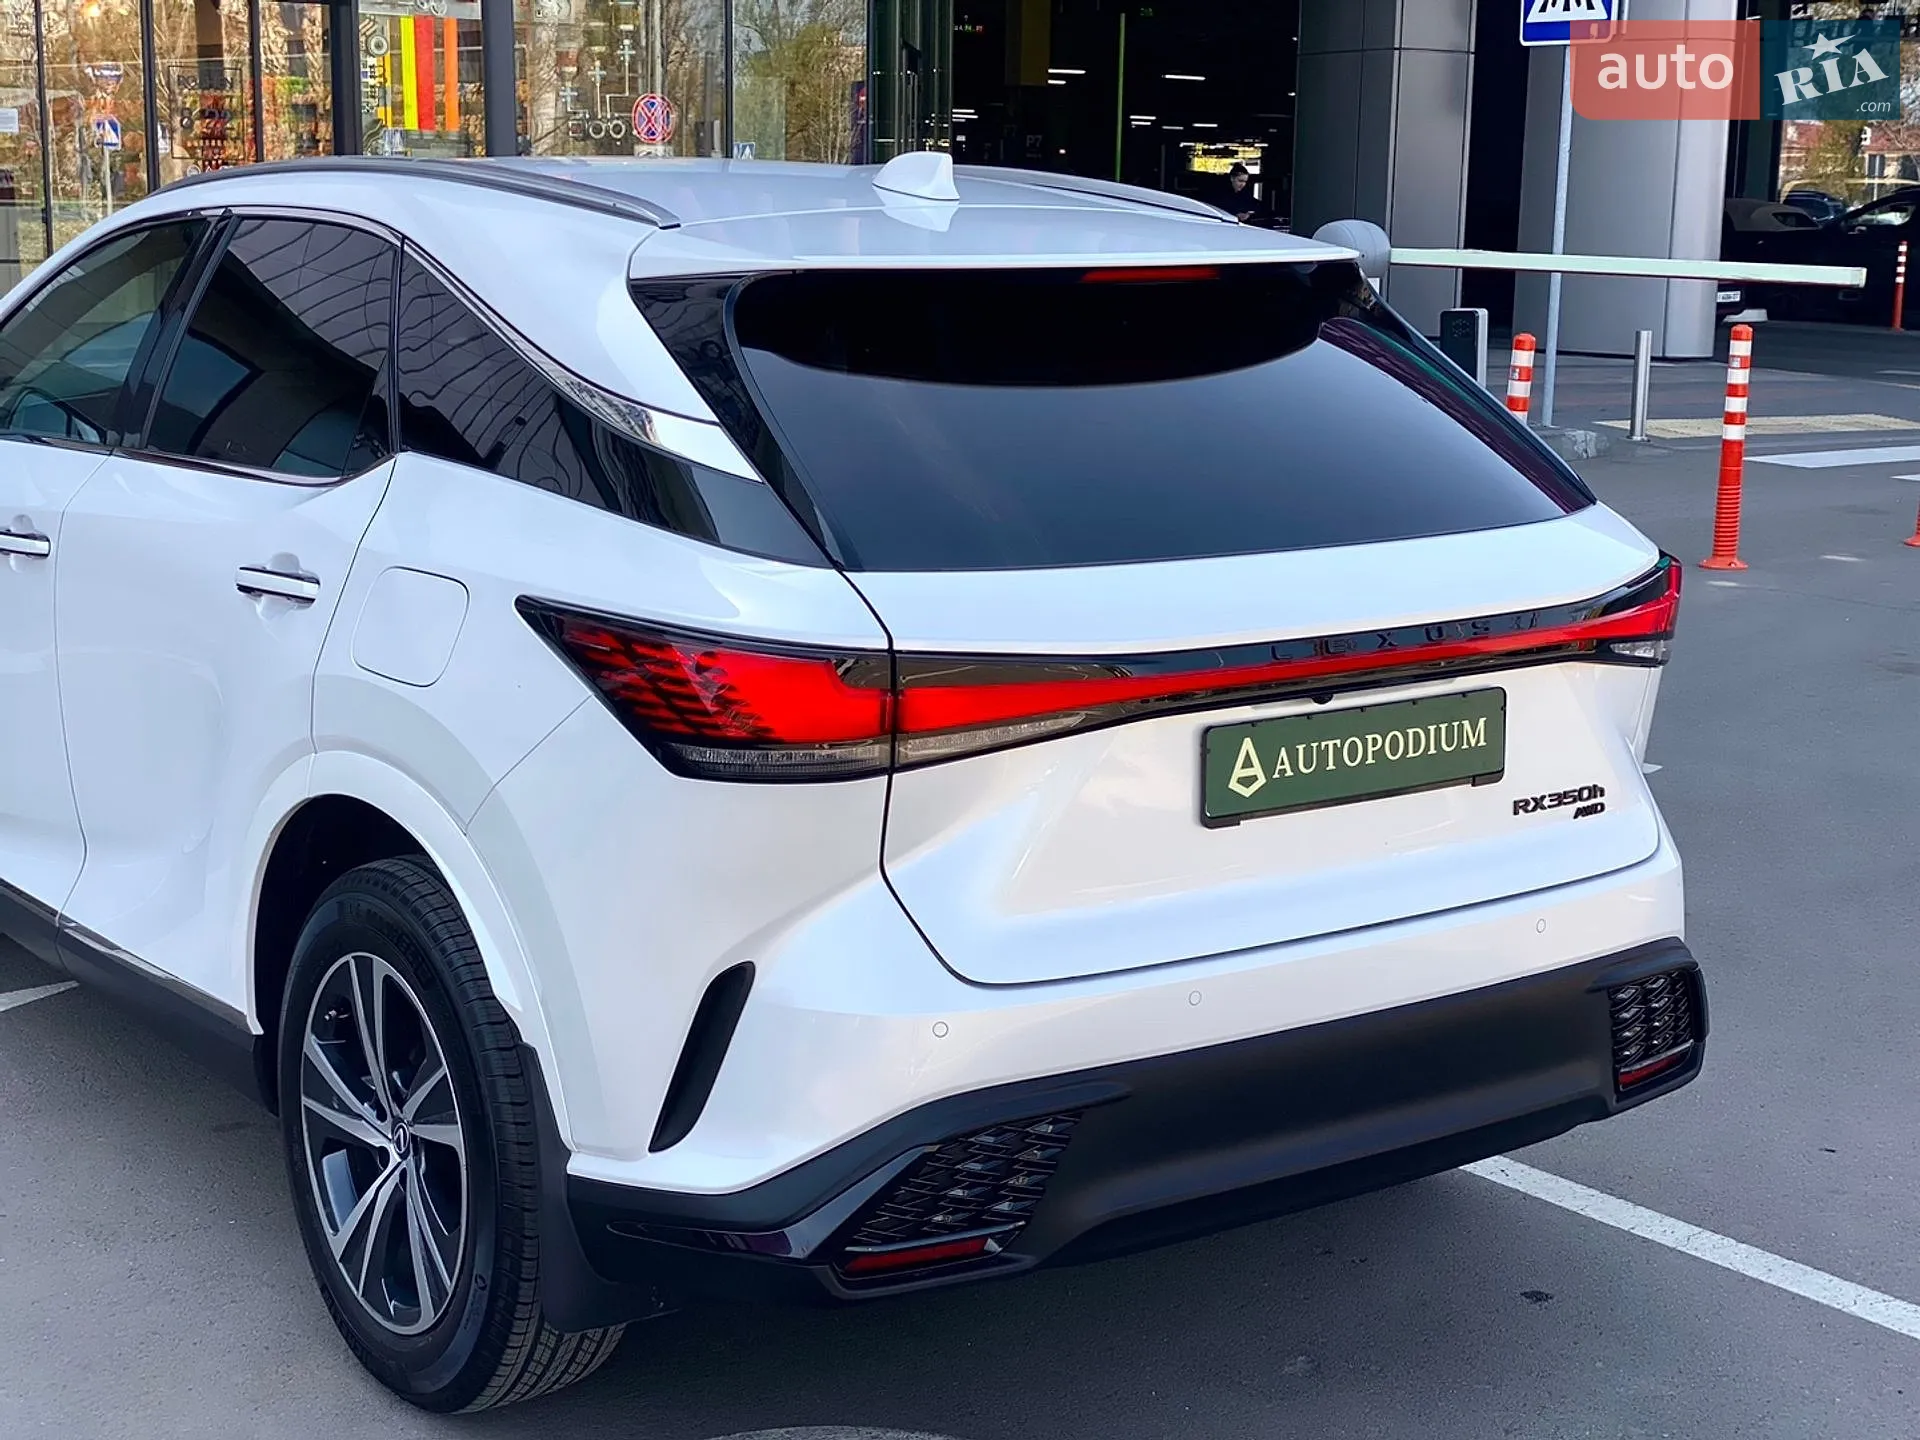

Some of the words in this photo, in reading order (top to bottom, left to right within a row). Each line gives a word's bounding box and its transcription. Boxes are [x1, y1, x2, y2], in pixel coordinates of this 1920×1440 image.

[1270, 620, 1491, 662] LEXUS
[1272, 717, 1488, 779] AUTOPODIUM
[1512, 783, 1606, 816] RX350h
[1573, 801, 1606, 820] AWD
